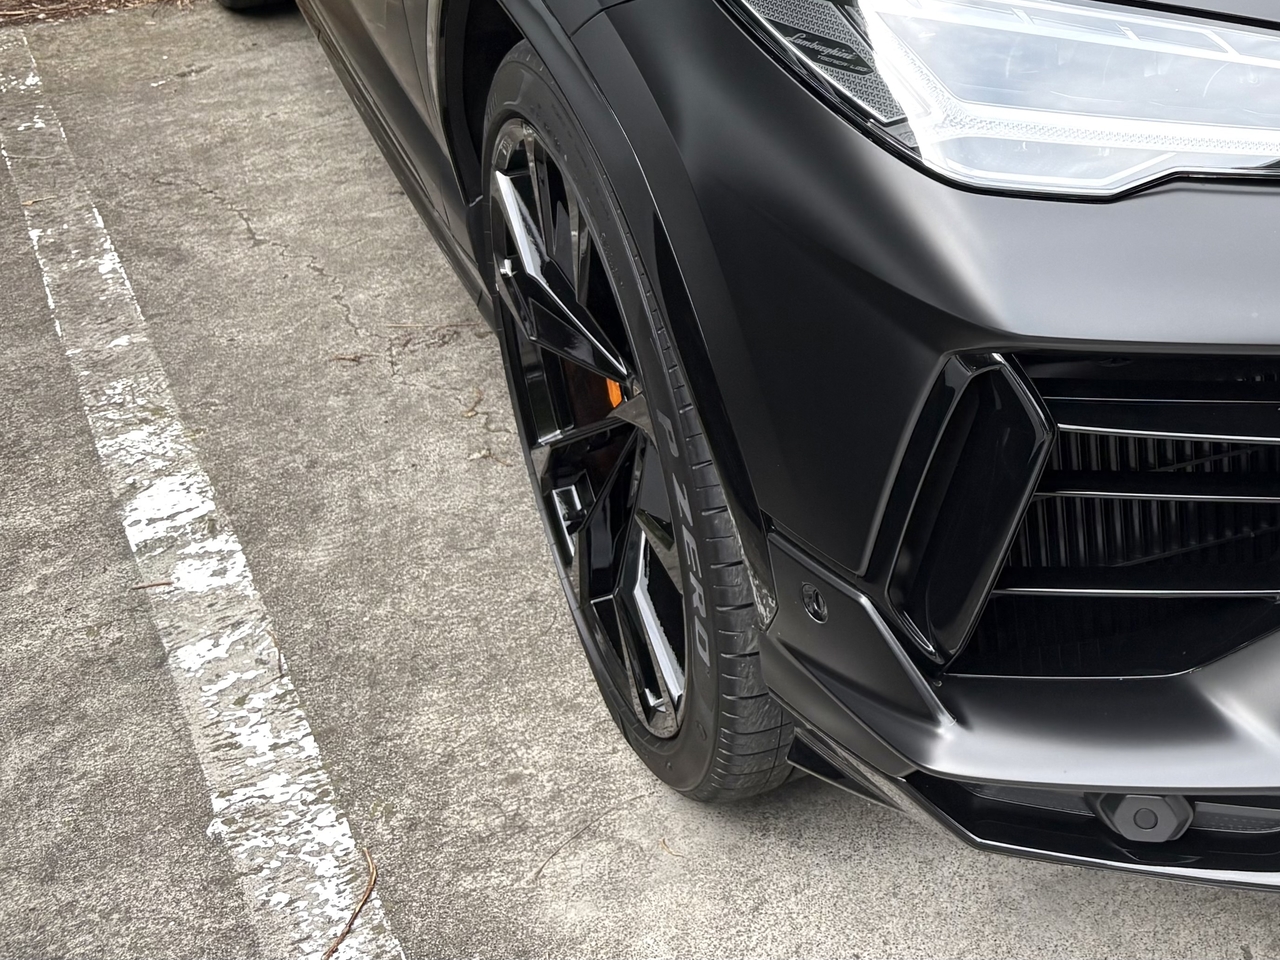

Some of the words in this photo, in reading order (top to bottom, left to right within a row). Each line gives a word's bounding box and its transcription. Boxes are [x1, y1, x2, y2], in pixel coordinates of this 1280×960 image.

[785, 33, 857, 59] Lamborghini
[656, 409, 679, 458] P
[672, 472, 710, 667] ZERO
